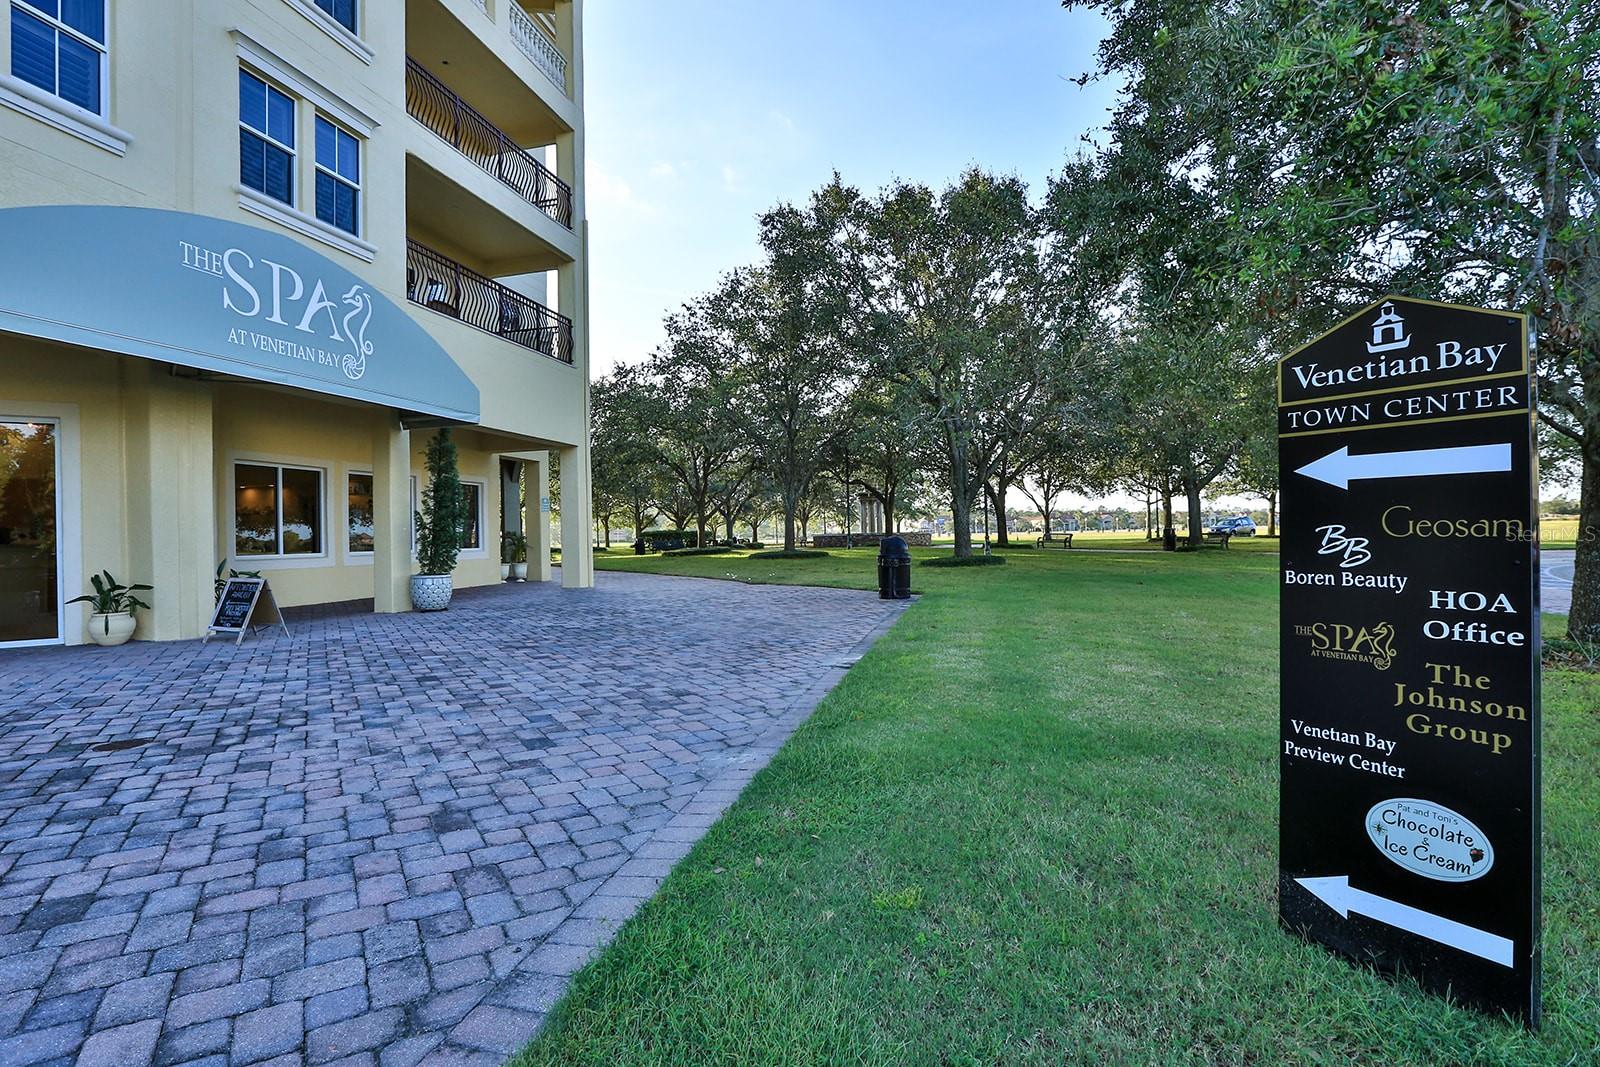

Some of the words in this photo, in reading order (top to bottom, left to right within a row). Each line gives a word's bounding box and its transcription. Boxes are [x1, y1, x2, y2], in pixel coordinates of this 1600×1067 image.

[179, 240, 223, 275] THE
[223, 248, 344, 342] SPA
[228, 327, 247, 345] AT
[249, 332, 315, 362] VENETIAN
[318, 350, 341, 368] BAY
[1292, 354, 1430, 389] Venetian
[1436, 341, 1508, 372] Bay
[1287, 402, 1370, 429] TOWN
[1383, 385, 1519, 418] CENTER
[1381, 505, 1523, 538] Geosam
[1285, 570, 1335, 586] Boren
[1341, 572, 1408, 594] Beauty
[1429, 590, 1518, 613] HOA
[1294, 625, 1312, 636] THE
[1311, 622, 1380, 655] SPA
[1423, 620, 1525, 646] Office
[1322, 651, 1358, 661] VENETIAN
[1358, 655, 1374, 663] BAY
[1425, 662, 1491, 690] The
[1394, 683, 1527, 721] Johnson
[1291, 719, 1360, 746] Venetian
[1364, 732, 1397, 757] Bay
[1406, 713, 1512, 754] Group
[1284, 740, 1345, 766] Preview
[1349, 754, 1406, 778] Center
[1382, 809, 1474, 847] Chocolate
[1397, 803, 1411, 813] Pat
[1412, 807, 1430, 817] and
[1384, 835, 1408, 856] Ice
[1413, 845, 1471, 875] Cream
[1421, 837, 1430, 847] &
